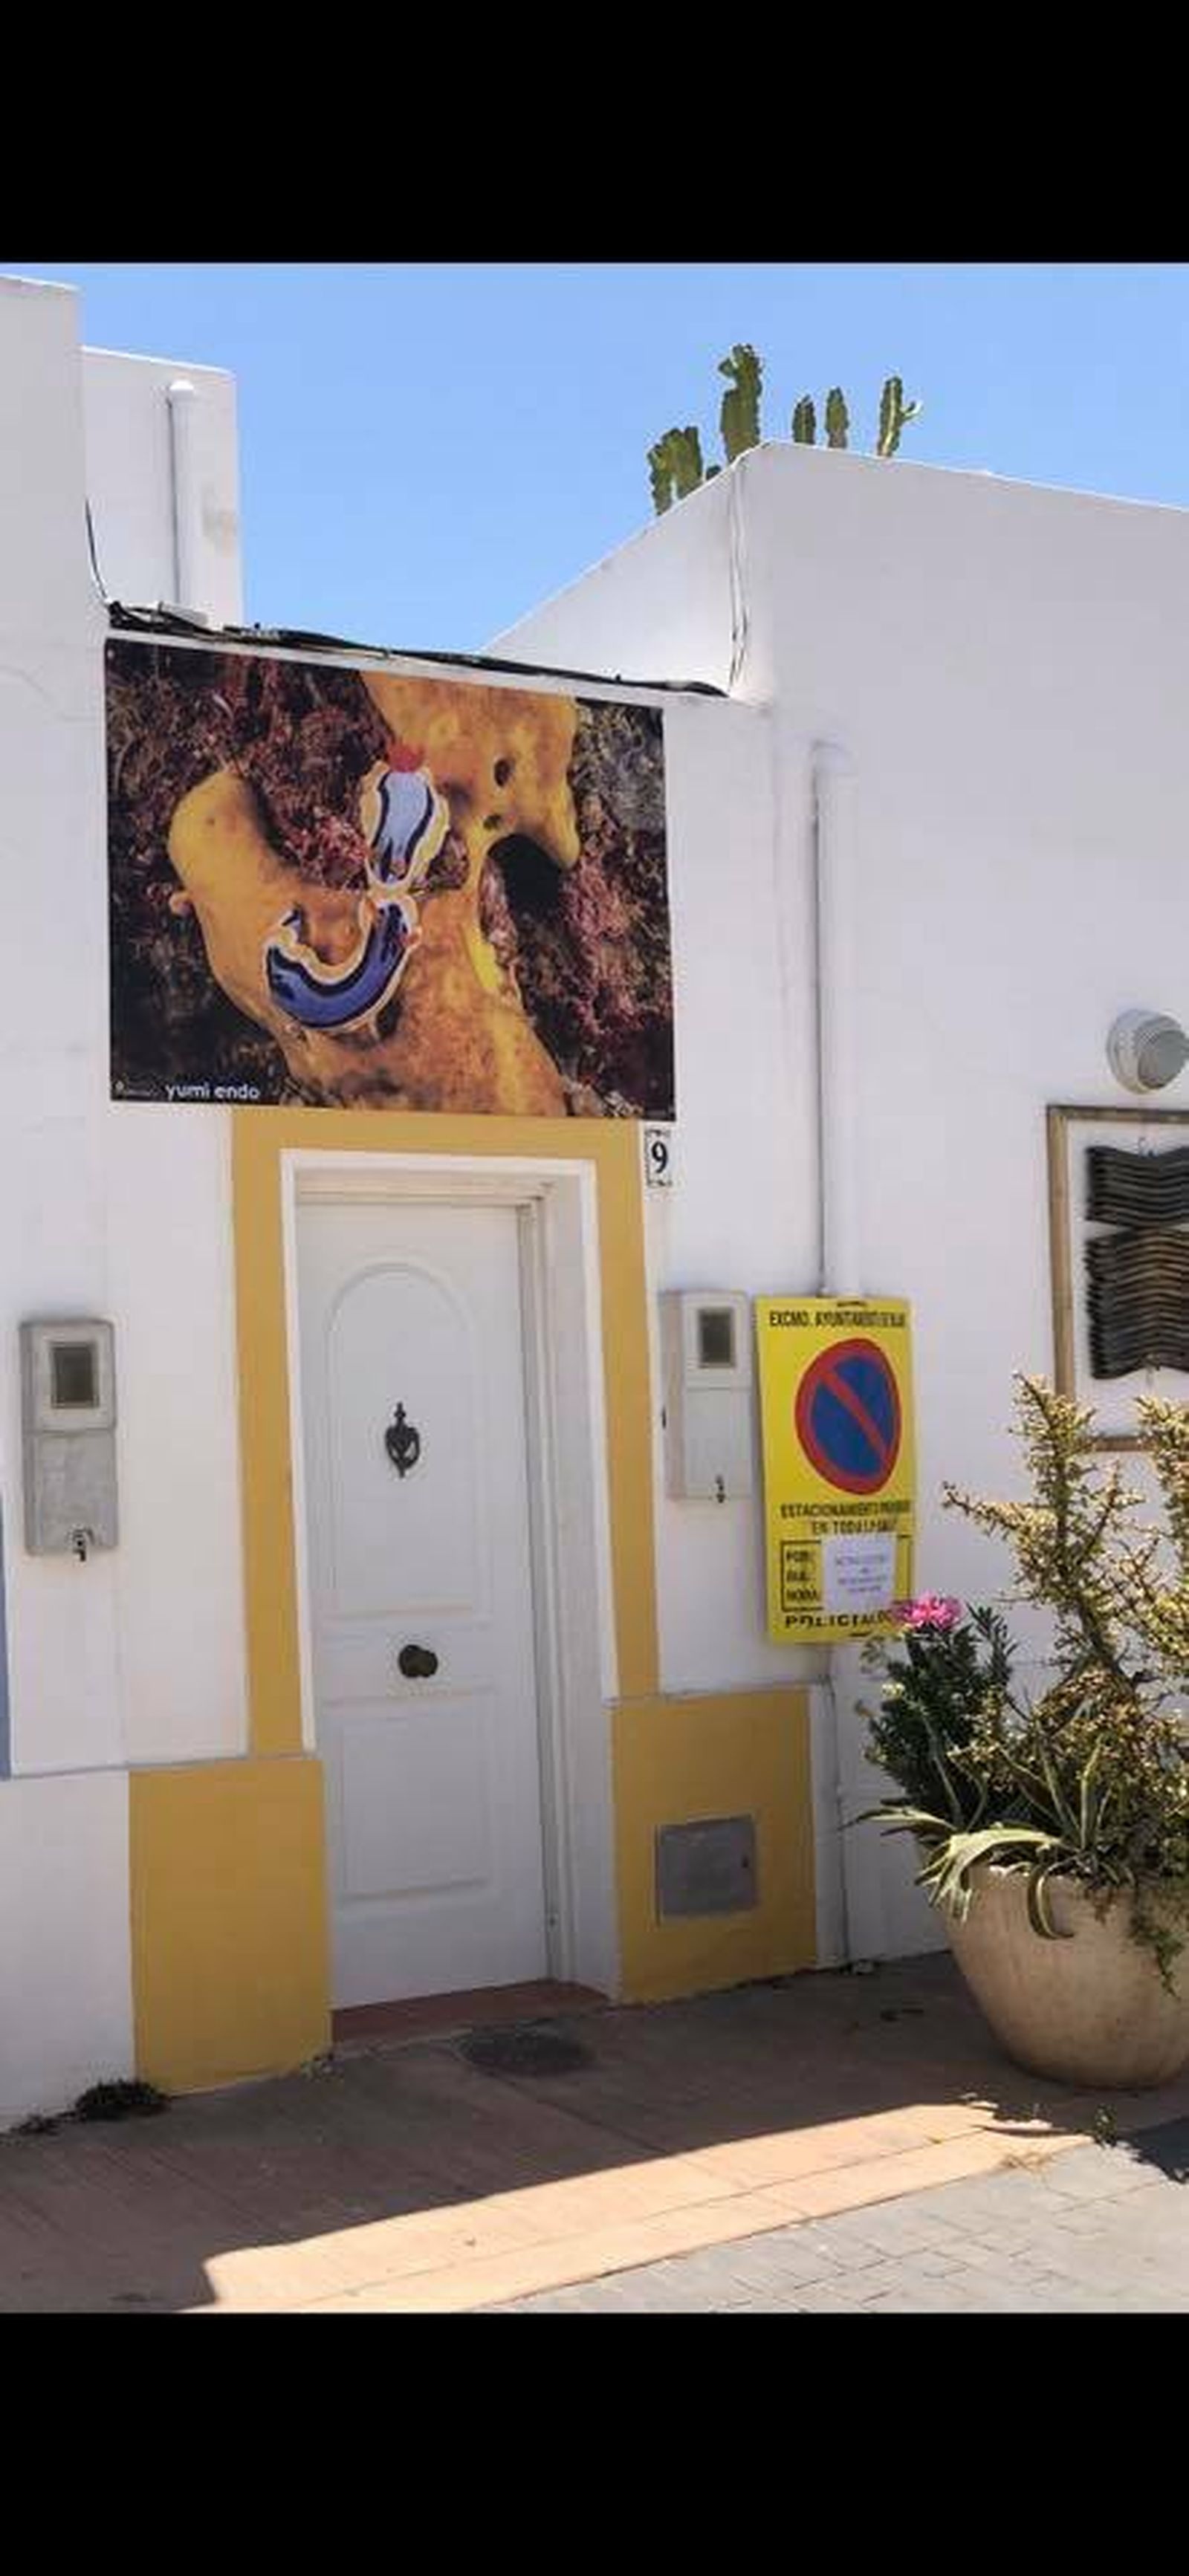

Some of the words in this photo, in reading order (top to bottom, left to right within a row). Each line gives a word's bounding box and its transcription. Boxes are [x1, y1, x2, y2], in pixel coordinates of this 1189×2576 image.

[165, 1082, 210, 1101] yumi
[213, 1083, 260, 1100] endo
[651, 1140, 668, 1174] 9
